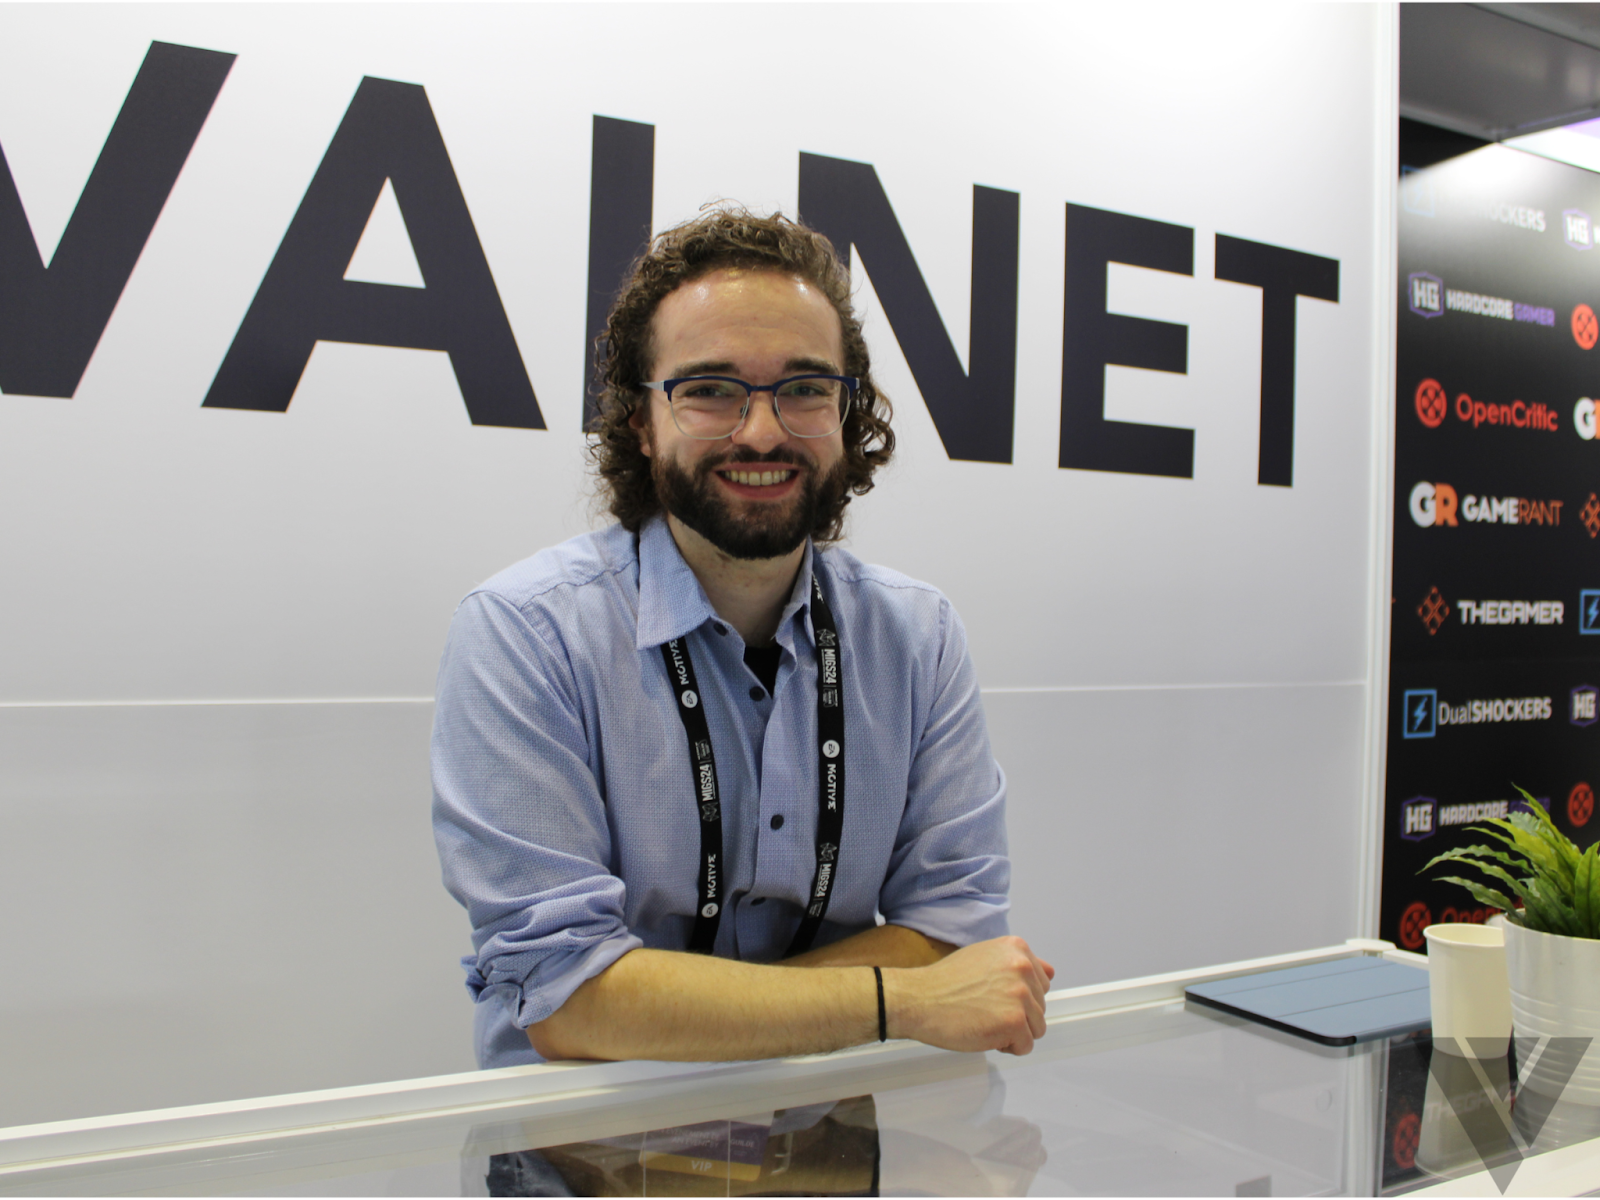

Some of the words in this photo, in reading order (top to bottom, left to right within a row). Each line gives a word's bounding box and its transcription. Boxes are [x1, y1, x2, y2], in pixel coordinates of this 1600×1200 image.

[1413, 278, 1440, 312] HG
[1455, 393, 1558, 432] OpenCritic
[1573, 397, 1600, 440] G
[1409, 480, 1458, 528] GR
[1457, 600, 1564, 624] THEGAMER
[824, 648, 837, 684] MIGS24
[1572, 692, 1596, 720] HG
[699, 763, 713, 802] MIGS24
[1405, 803, 1433, 834] HG
[816, 863, 832, 898] MIGS24
[691, 1160, 713, 1171] VIP
